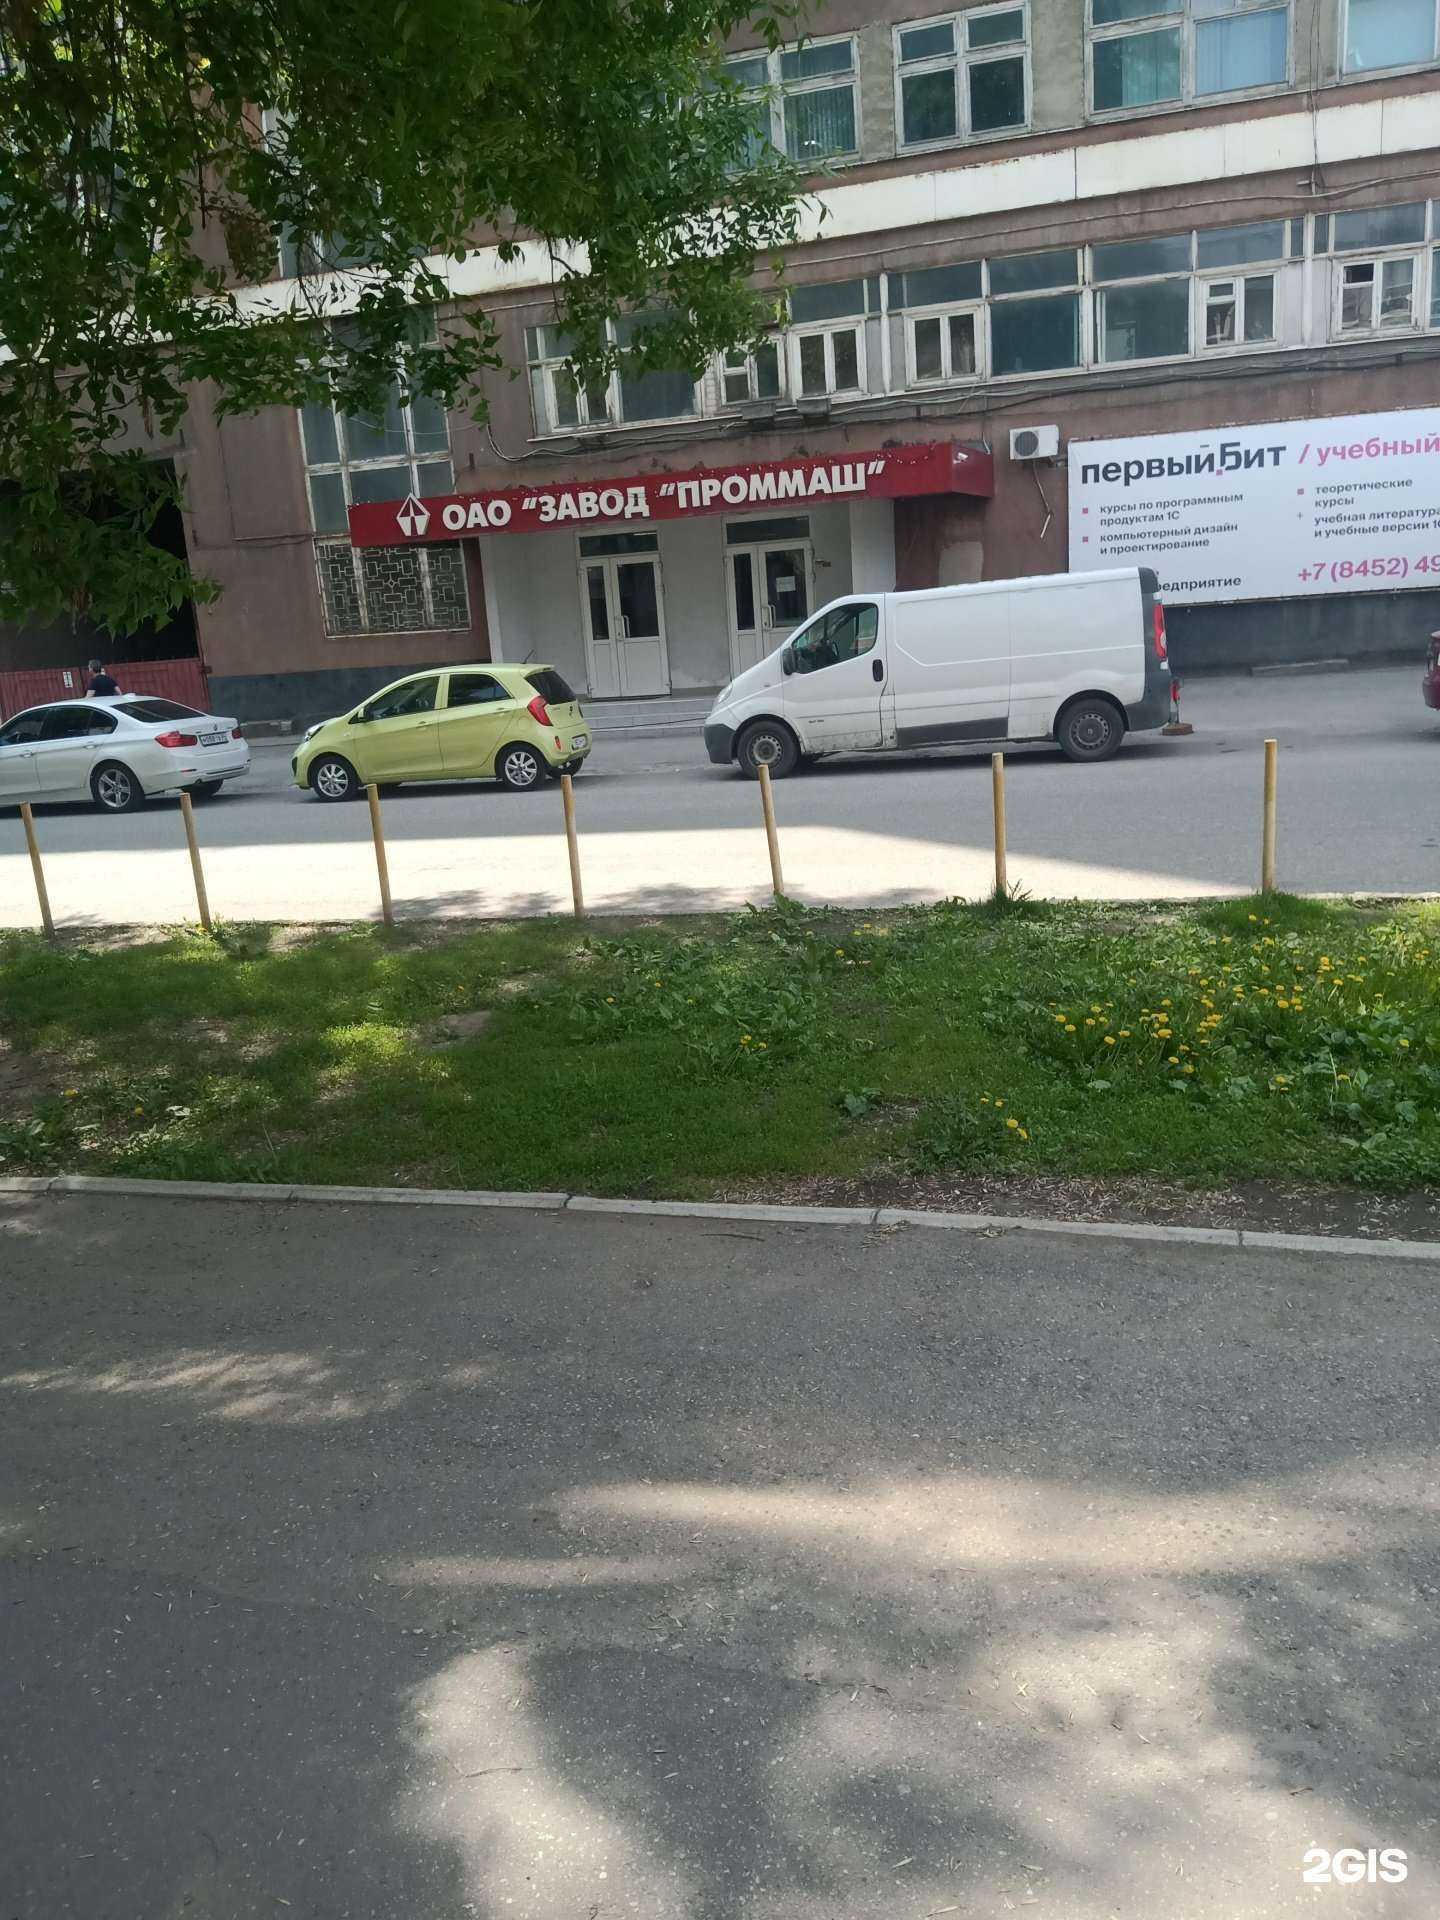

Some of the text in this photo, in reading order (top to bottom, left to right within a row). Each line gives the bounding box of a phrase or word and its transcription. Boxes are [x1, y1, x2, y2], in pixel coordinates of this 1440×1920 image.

[1316, 432, 1440, 467] учебный
[1316, 477, 1414, 495] теоретические
[1099, 493, 1244, 515] курсы по программным
[1314, 496, 1355, 509] курсы
[442, 499, 512, 531] ОАО
[1099, 513, 1165, 528] продуктам
[1314, 513, 1366, 527] учебная
[1099, 523, 1239, 543] компьютерный дизайн
[1314, 529, 1323, 538] и
[1324, 525, 1380, 539] учебные
[1382, 522, 1430, 534] версии
[1099, 538, 1210, 556] и проектирование
[1298, 562, 1327, 582] +7
[1330, 556, 1410, 583] (8452)
